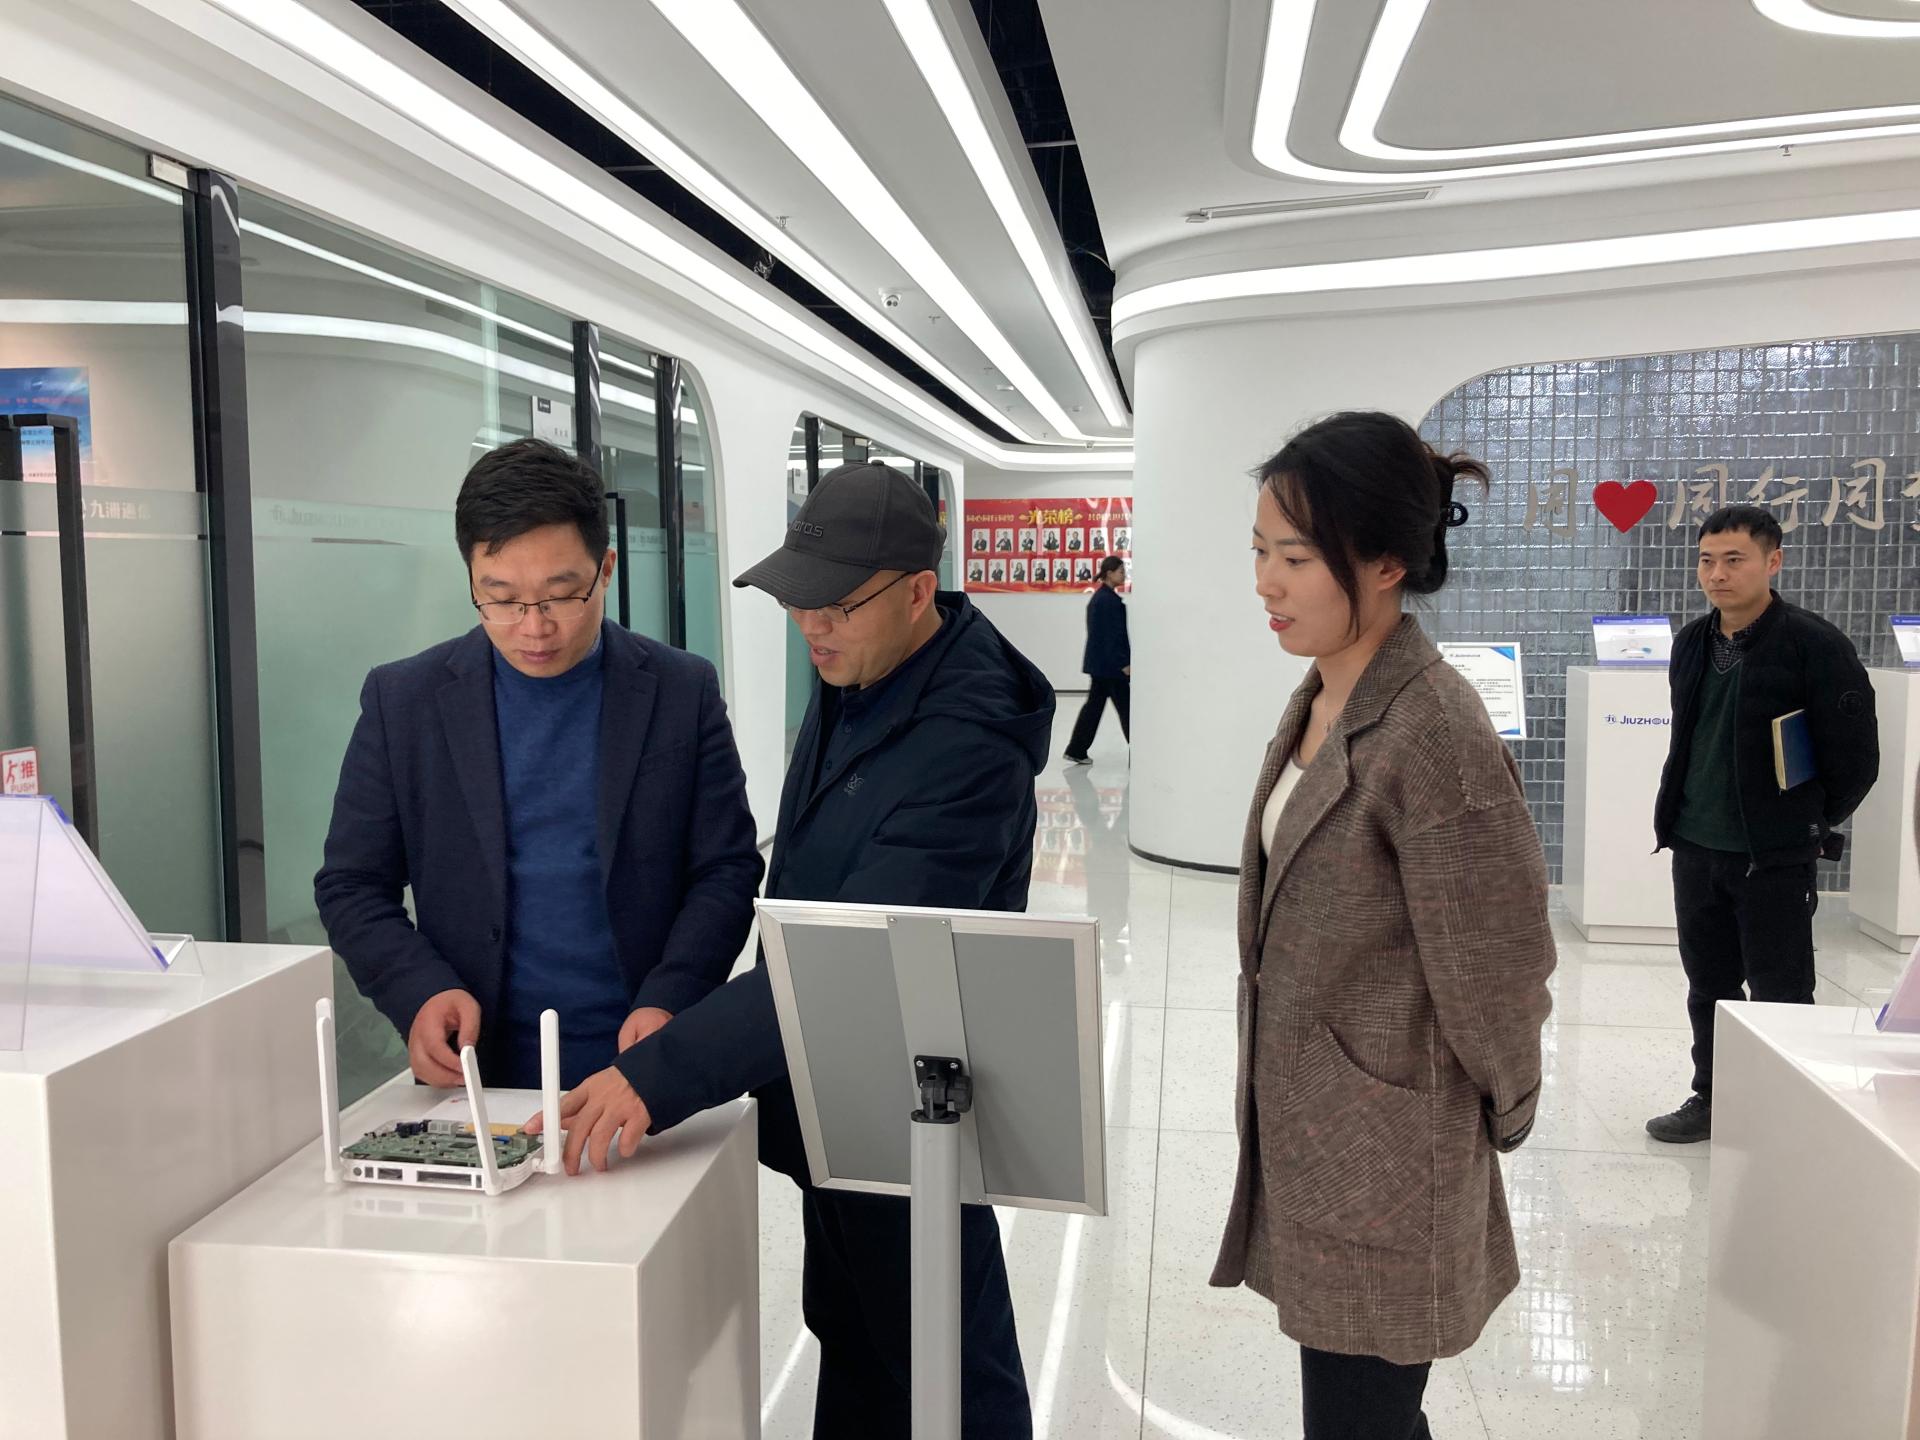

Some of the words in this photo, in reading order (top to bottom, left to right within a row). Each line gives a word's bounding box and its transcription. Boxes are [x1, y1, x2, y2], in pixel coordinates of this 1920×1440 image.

[1524, 467, 1578, 539] 同
[1026, 507, 1074, 526] 光荣榜
[20, 760, 35, 779] 推
[10, 783, 35, 792] PUSH
